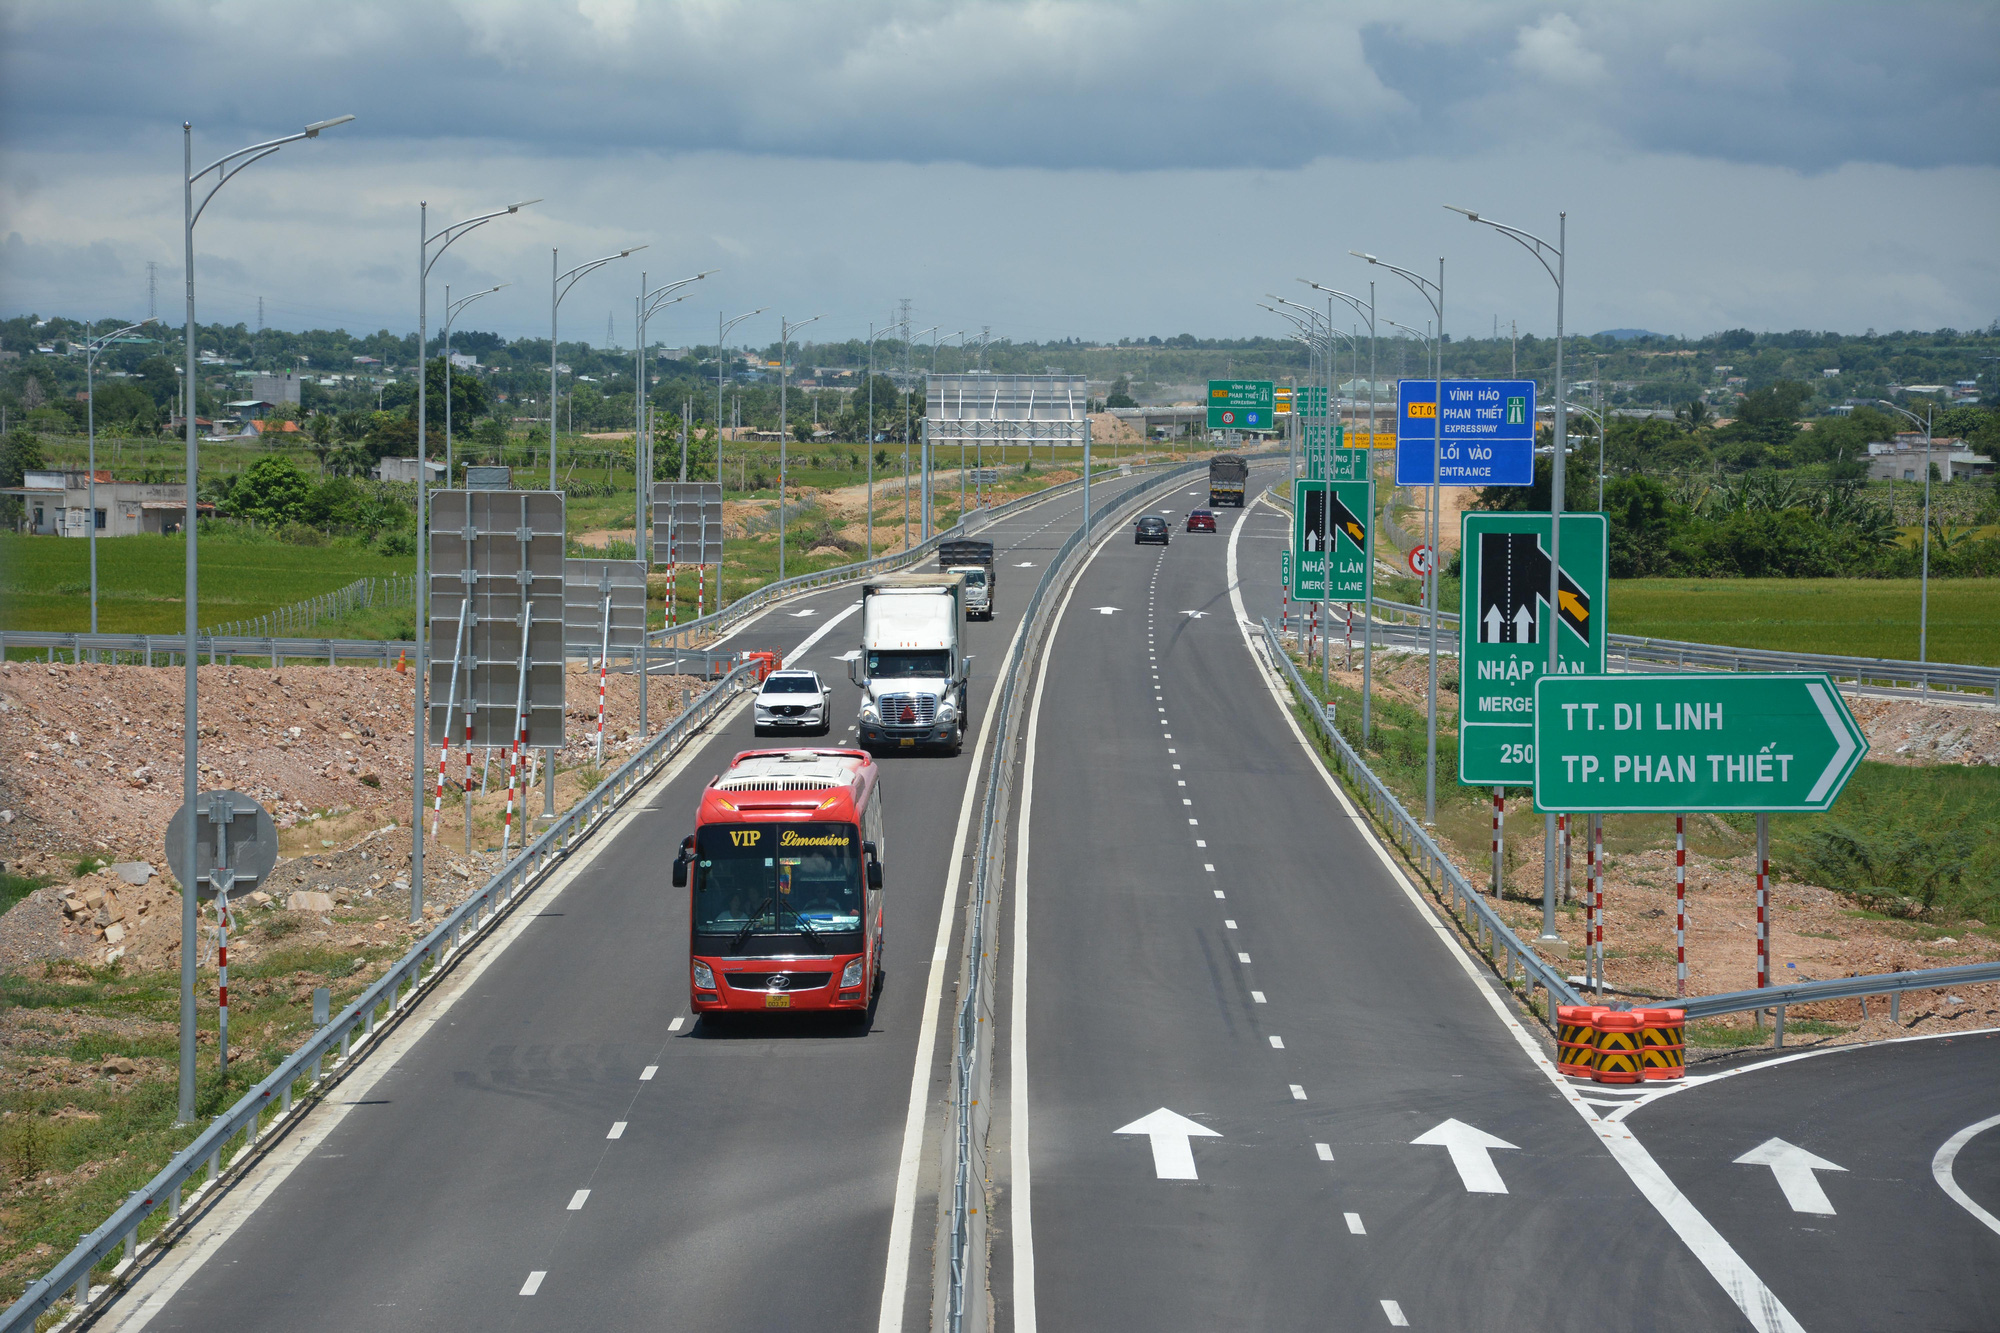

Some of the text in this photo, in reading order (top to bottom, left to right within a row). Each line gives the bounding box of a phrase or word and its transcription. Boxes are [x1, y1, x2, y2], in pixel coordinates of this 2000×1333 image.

[1450, 387, 1500, 400] VĨNH HẢO
[1410, 406, 1436, 415] CT.01
[1444, 404, 1503, 419] PHAN THIẾT
[1445, 425, 1497, 433] EXPRESSWAY
[1440, 442, 1492, 460] LỐI VÀO
[1440, 467, 1491, 476] ENTRANCE
[1302, 558, 1363, 575] NHẬP LÀN
[1338, 582, 1363, 591] LANE
[1478, 654, 1534, 686] NHẬP
[1479, 696, 1533, 712] MERGE
[1561, 702, 1723, 731] TT. DI LINH
[1501, 744, 1533, 763] 250
[1561, 742, 1794, 783] TP. PHAN THIẾT
[730, 830, 849, 847] VIP Limousine
